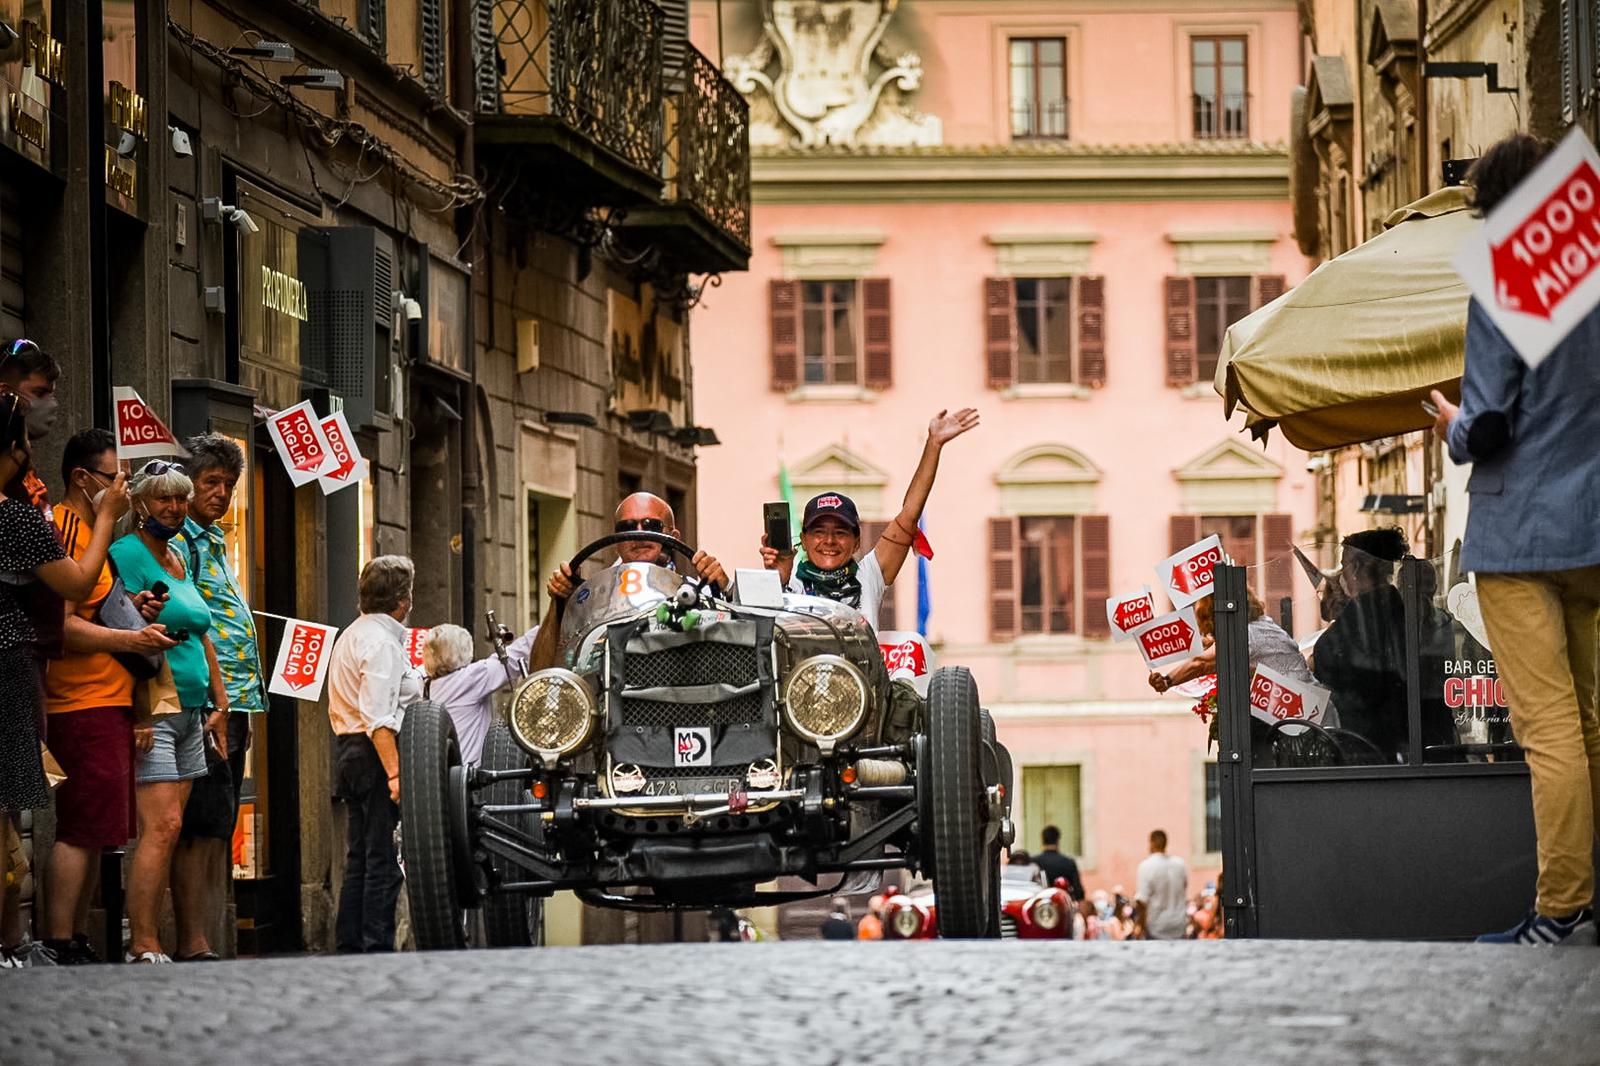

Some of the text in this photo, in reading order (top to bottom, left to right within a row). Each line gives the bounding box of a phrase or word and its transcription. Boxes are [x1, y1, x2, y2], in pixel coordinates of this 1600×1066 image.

[1511, 178, 1594, 267] 1000
[262, 265, 308, 322] PROFUMERIA
[123, 425, 168, 441] MIGL
[278, 420, 307, 466] MIGLIA
[294, 416, 318, 456] 1000
[325, 425, 348, 463] 1000
[1181, 551, 1217, 574] 1000
[1146, 624, 1180, 643] 1000
[1150, 637, 1187, 658] MIGLIA
[286, 626, 307, 675] MIGLIA
[302, 633, 322, 676] 1000
[1444, 660, 1498, 674] BAR GE
[1250, 691, 1288, 719] MIGIA
[1256, 678, 1293, 704] 1000
